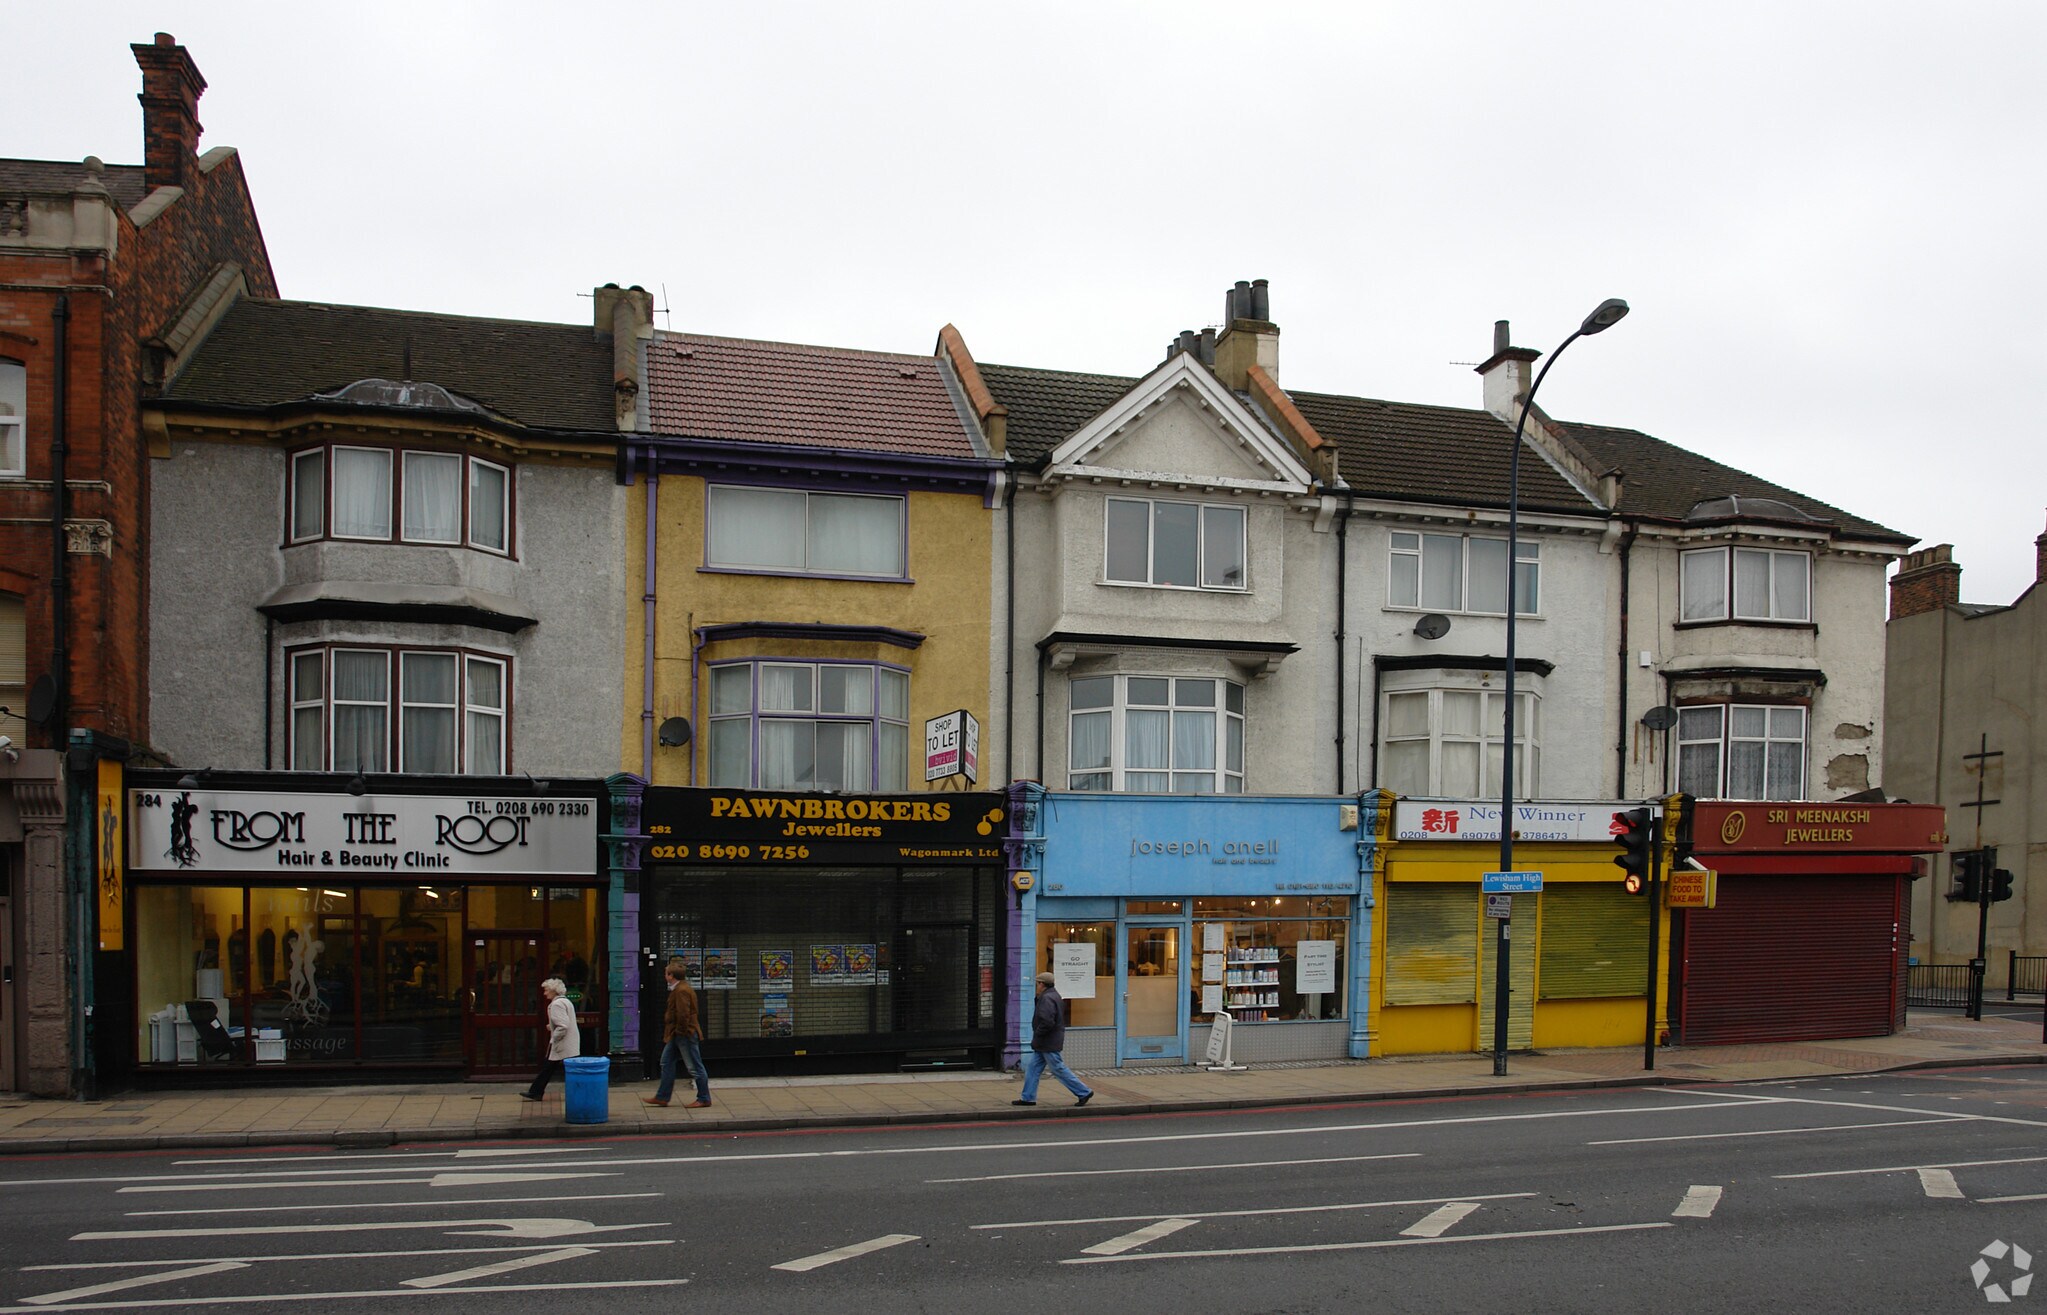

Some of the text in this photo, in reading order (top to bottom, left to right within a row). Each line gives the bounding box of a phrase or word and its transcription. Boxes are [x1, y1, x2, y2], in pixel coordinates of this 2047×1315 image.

[935, 719, 952, 733] SHOP
[928, 730, 959, 752] TO LET
[136, 794, 162, 807] 284
[467, 801, 589, 815] TEL. 0208 690 2330
[710, 797, 951, 822] PAWNBROKERS
[1517, 807, 1586, 822] Winner
[1421, 808, 1460, 834] 新
[1768, 810, 1871, 824] SRI MEENAKSHI
[211, 810, 531, 855] FROM THE ROOT
[649, 825, 672, 834] 282
[782, 823, 882, 837] Jewellers
[1400, 831, 1428, 839] 0208
[1522, 832, 1568, 840] 3786473
[1784, 828, 1854, 845] JEWELLERS
[651, 844, 810, 860] 020 8690 7256
[899, 847, 1000, 858] Wagonmark Ltd
[1131, 839, 1279, 858] joseph anell
[278, 849, 450, 870] Hair & Beauty Clinic
[1484, 873, 1541, 884] Lewisham High
[1673, 875, 1704, 884] CHINESE
[1502, 883, 1523, 891] Street
[1673, 885, 1702, 893] FOOD TO
